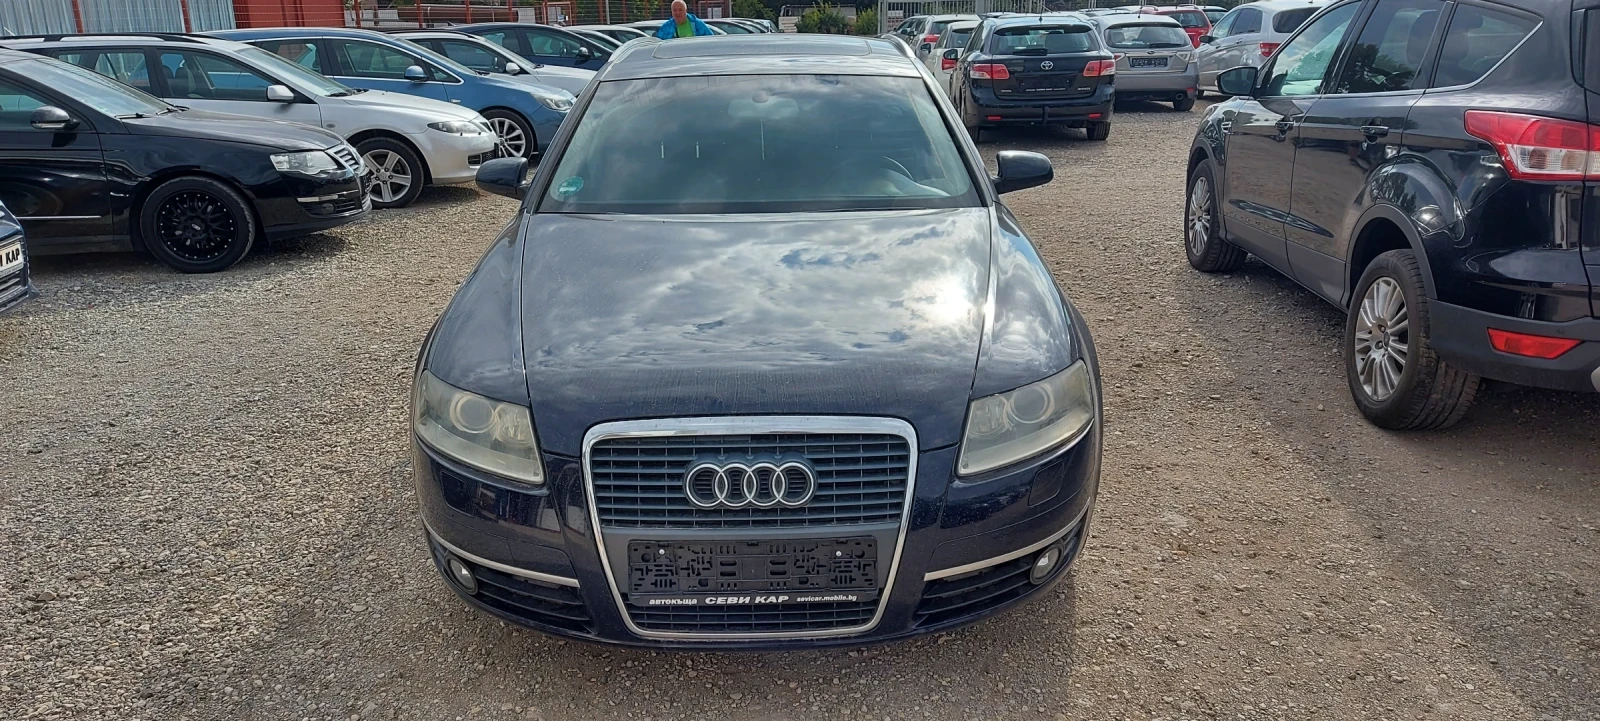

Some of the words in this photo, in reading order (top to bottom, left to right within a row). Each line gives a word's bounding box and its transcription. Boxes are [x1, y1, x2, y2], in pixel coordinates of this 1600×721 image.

[5, 248, 20, 264] КАР
[705, 596, 751, 604] СЕВИ
[754, 595, 790, 604] КАР
[796, 594, 857, 602] sevicar.mobile.bg
